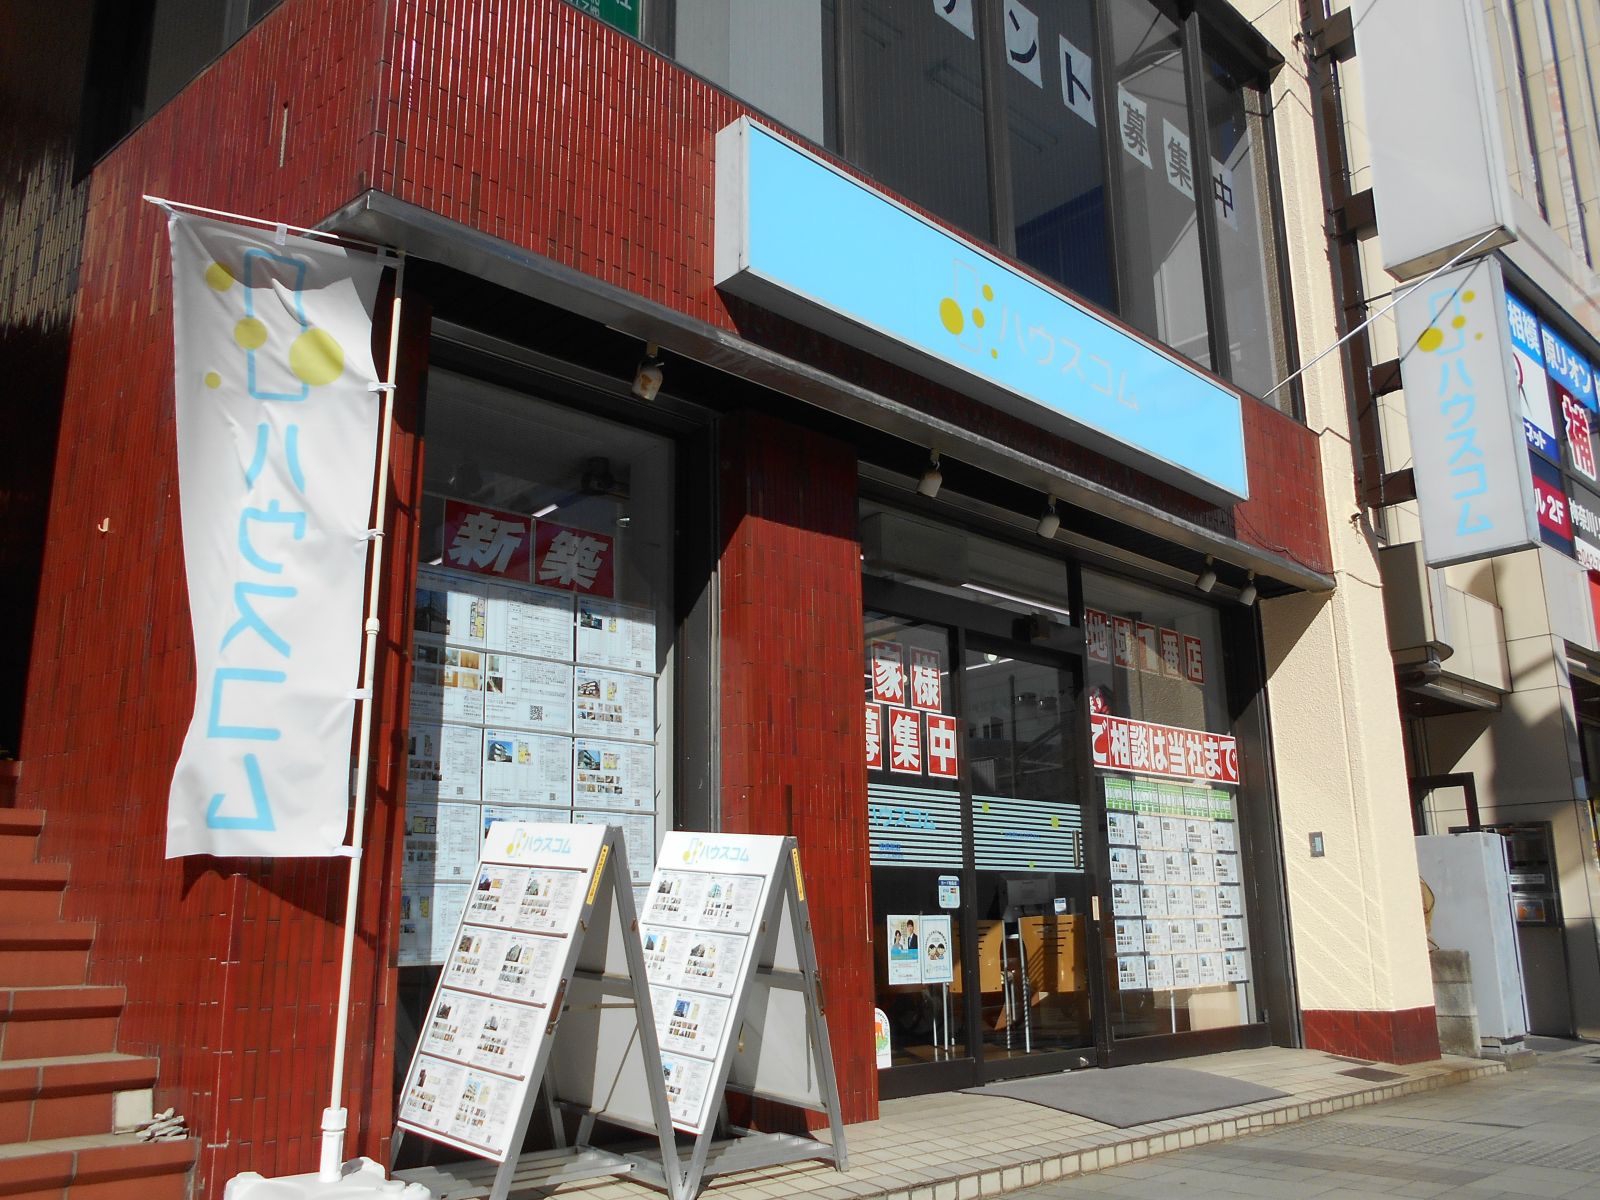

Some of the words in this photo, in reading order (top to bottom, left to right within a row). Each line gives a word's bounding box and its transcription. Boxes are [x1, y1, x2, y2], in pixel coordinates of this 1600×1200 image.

[943, 0, 1233, 218] ント募集中
[999, 304, 1139, 412] ハウスコム
[1507, 300, 1600, 408] 相模原リオン
[1438, 357, 1495, 537] ハウスコム
[1547, 494, 1564, 525] 2F
[447, 511, 609, 589] 新築
[875, 646, 939, 706] 家様
[1088, 612, 1203, 681] 地域1番店
[1091, 719, 1237, 780] ご相談は当社まで
[523, 835, 572, 854] ハウスコム
[700, 845, 751, 862] ハウスコム
